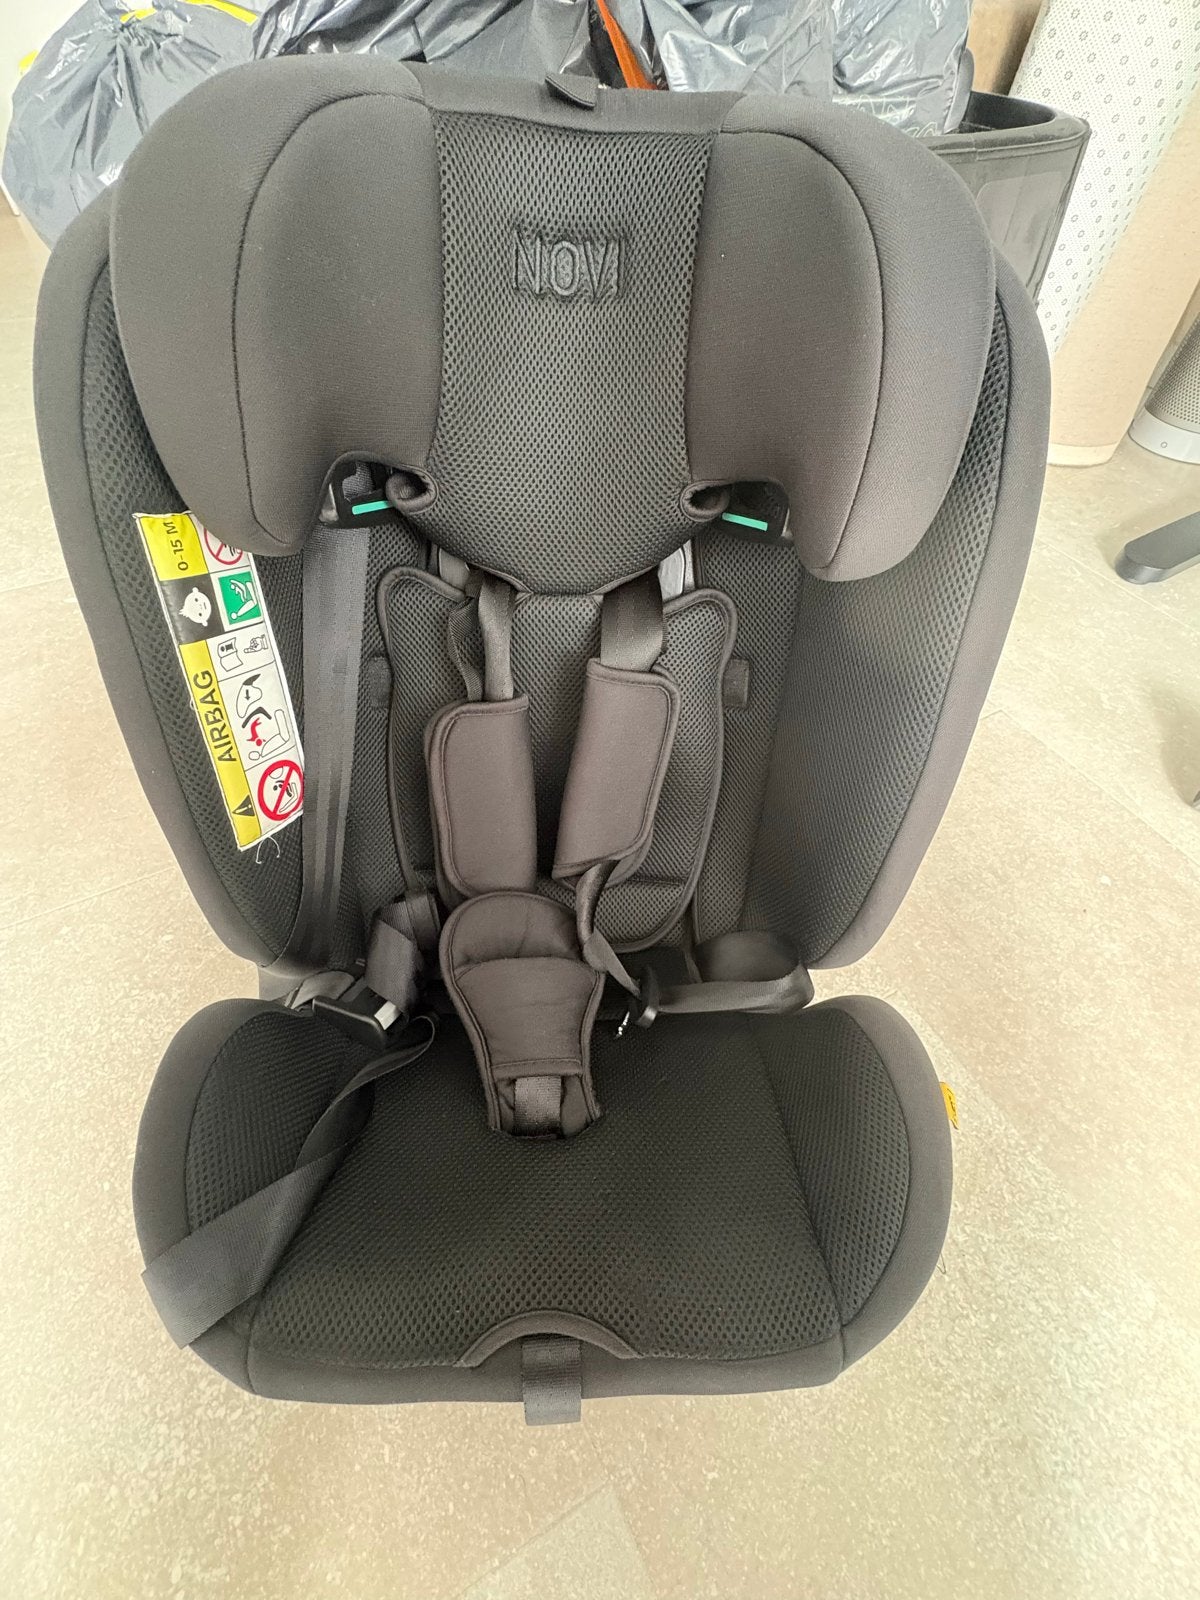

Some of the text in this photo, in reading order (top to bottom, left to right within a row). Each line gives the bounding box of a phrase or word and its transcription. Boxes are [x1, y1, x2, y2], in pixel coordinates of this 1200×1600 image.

[512, 229, 624, 300] NOVI
[163, 520, 189, 571] 0-15 M
[194, 670, 237, 763] AIRBAG
